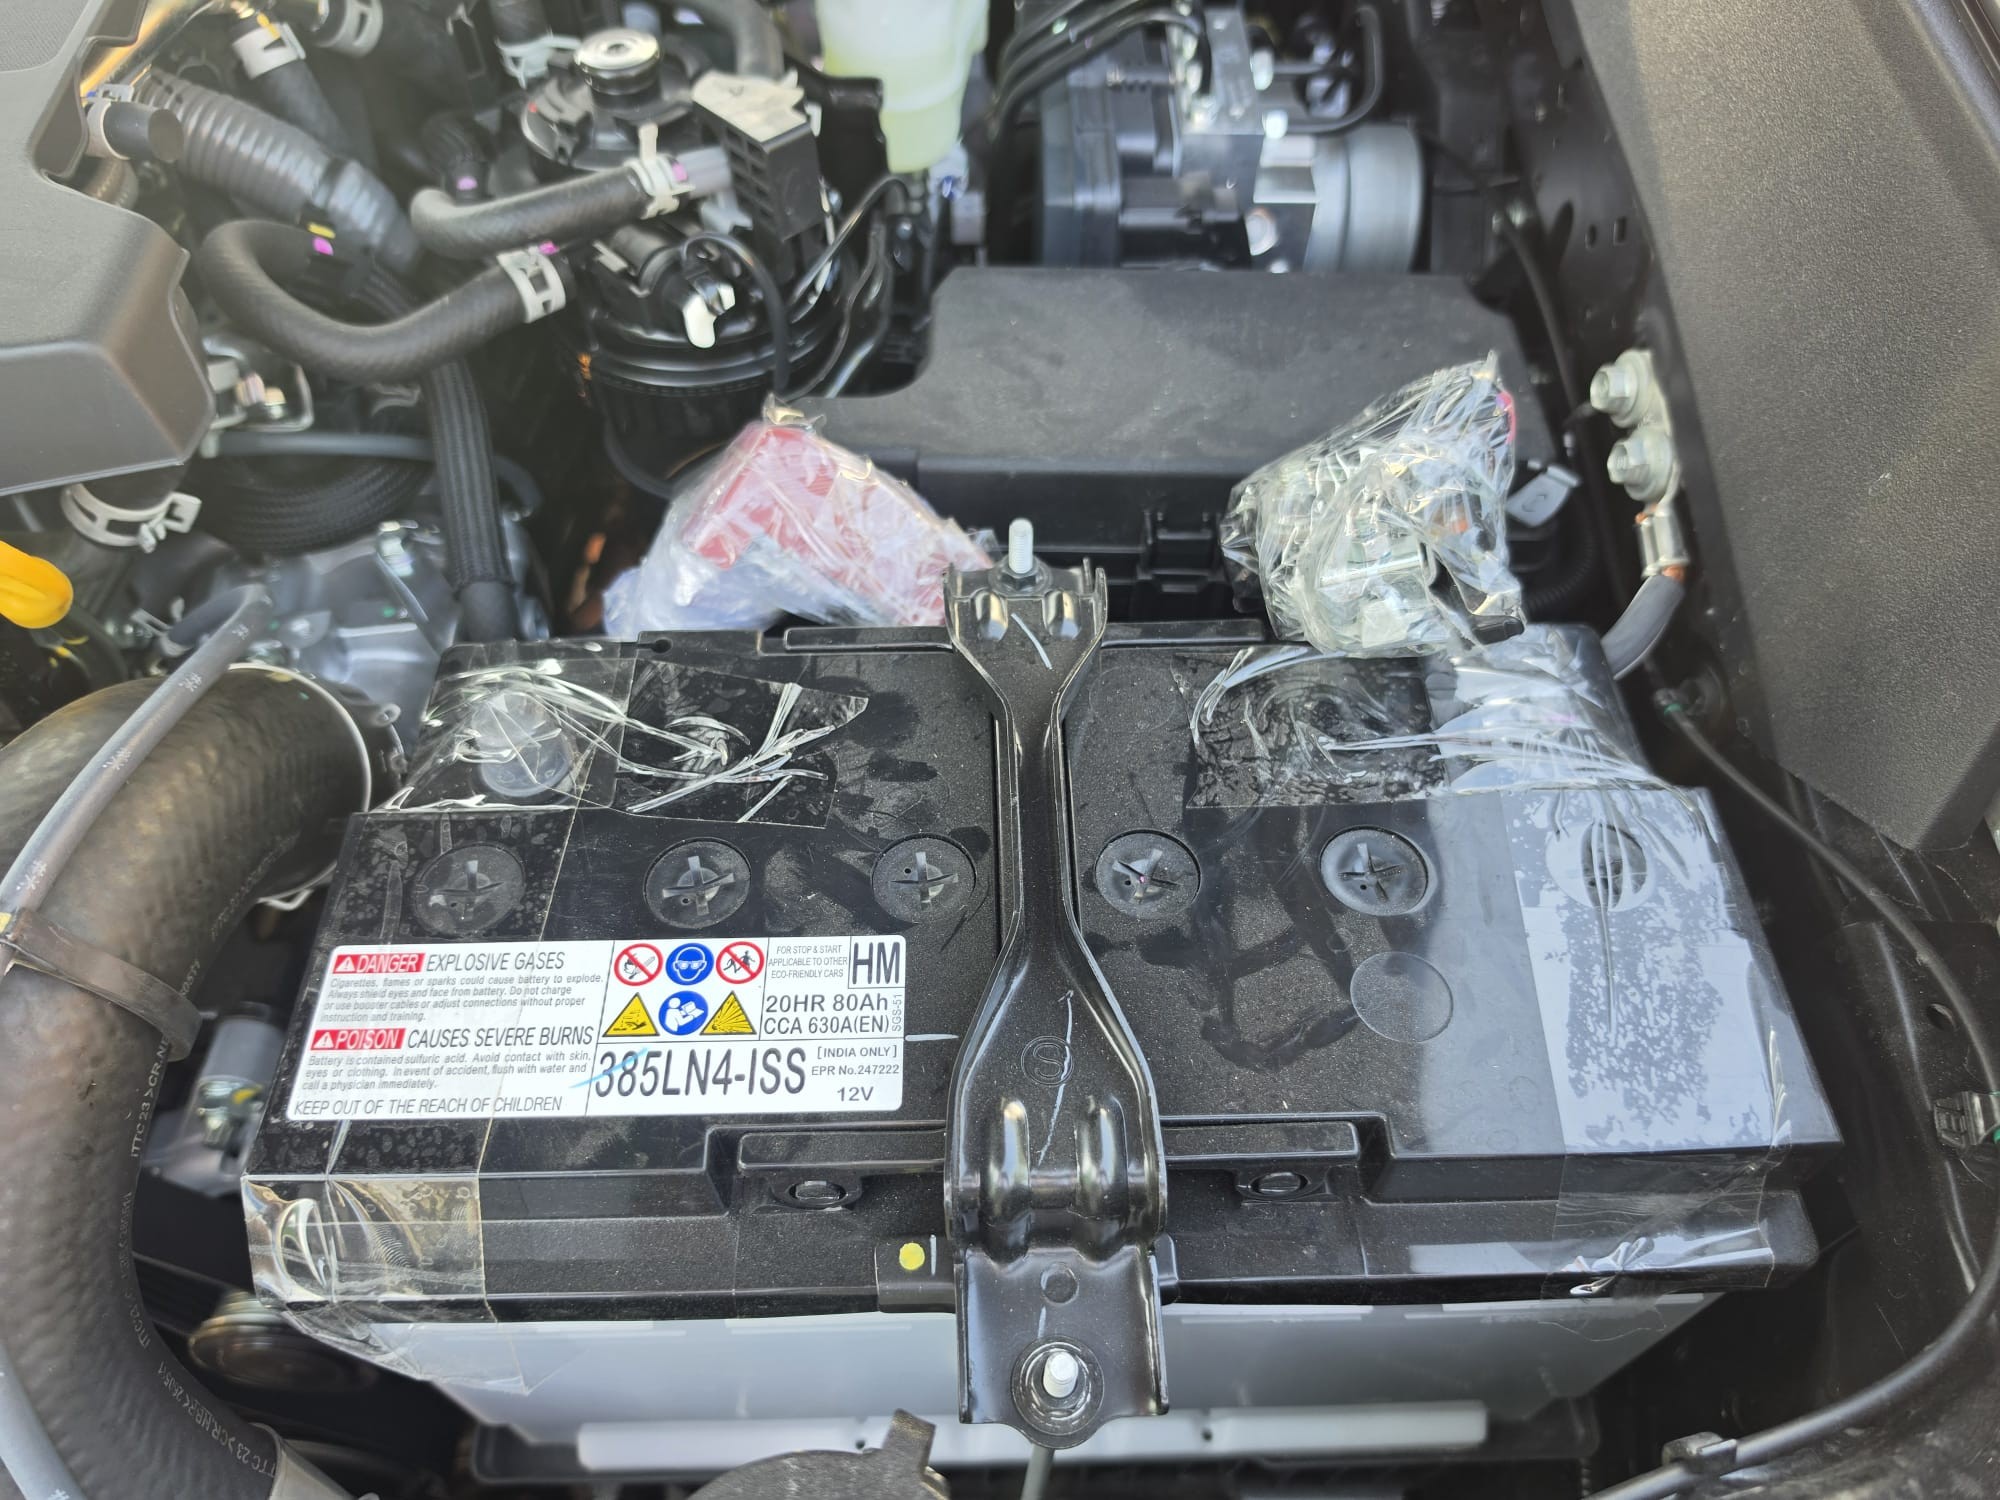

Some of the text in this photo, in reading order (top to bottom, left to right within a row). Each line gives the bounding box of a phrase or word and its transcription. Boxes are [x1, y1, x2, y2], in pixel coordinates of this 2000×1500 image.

[776, 945, 842, 954] FOR STOP & START
[357, 954, 419, 973] DANGER
[426, 952, 565, 972] EXPLOSIVE GASES
[768, 956, 848, 967] APPLICABLE TO OTHER
[852, 942, 900, 985] HM
[382, 977, 411, 987] flames
[414, 978, 424, 986] or
[427, 976, 456, 987] sparks
[460, 976, 485, 985] could
[488, 977, 515, 985] cause
[518, 974, 550, 986] battery
[553, 975, 563, 983] to
[566, 973, 604, 984] explode.
[771, 968, 844, 979] ECO-FRIENDLY CARS
[328, 985, 572, 1000] Always shield eyes and face from battery. Do not charge
[323, 997, 586, 1010] or use booster cables or adjust connections without proper
[766, 993, 889, 1013] 20HR 80Ah
[320, 1011, 426, 1023] instruction and training.
[892, 994, 903, 1032] SGS-51
[763, 1015, 890, 1034] CCA 630A(EN)
[335, 1029, 400, 1049] POISON
[407, 1025, 594, 1048] CAUSES SEVERE BURNS
[308, 1055, 343, 1067] Battery
[345, 1056, 354, 1065] is
[356, 1055, 404, 1065] contained
[405, 1054, 440, 1065] sulfuric
[472, 1052, 500, 1063] Avoid
[504, 1051, 541, 1062] contact
[546, 1051, 565, 1061] with
[305, 1068, 328, 1079] eyes
[332, 1068, 344, 1077] or
[403, 1067, 431, 1076] event
[433, 1066, 444, 1076] of
[491, 1064, 515, 1074] flush
[517, 1063, 537, 1073] with
[539, 1063, 566, 1073] water
[569, 1062, 587, 1073] and
[595, 1046, 806, 1098] 385LN4-ISS
[811, 1064, 900, 1076] EPR No.247222
[302, 1080, 319, 1090] call
[321, 1081, 329, 1090] a
[330, 1079, 376, 1091] physician
[837, 1086, 874, 1102] 12V
[294, 1096, 563, 1115] KEEP OUT OF THE REACH OF CHILDREN
